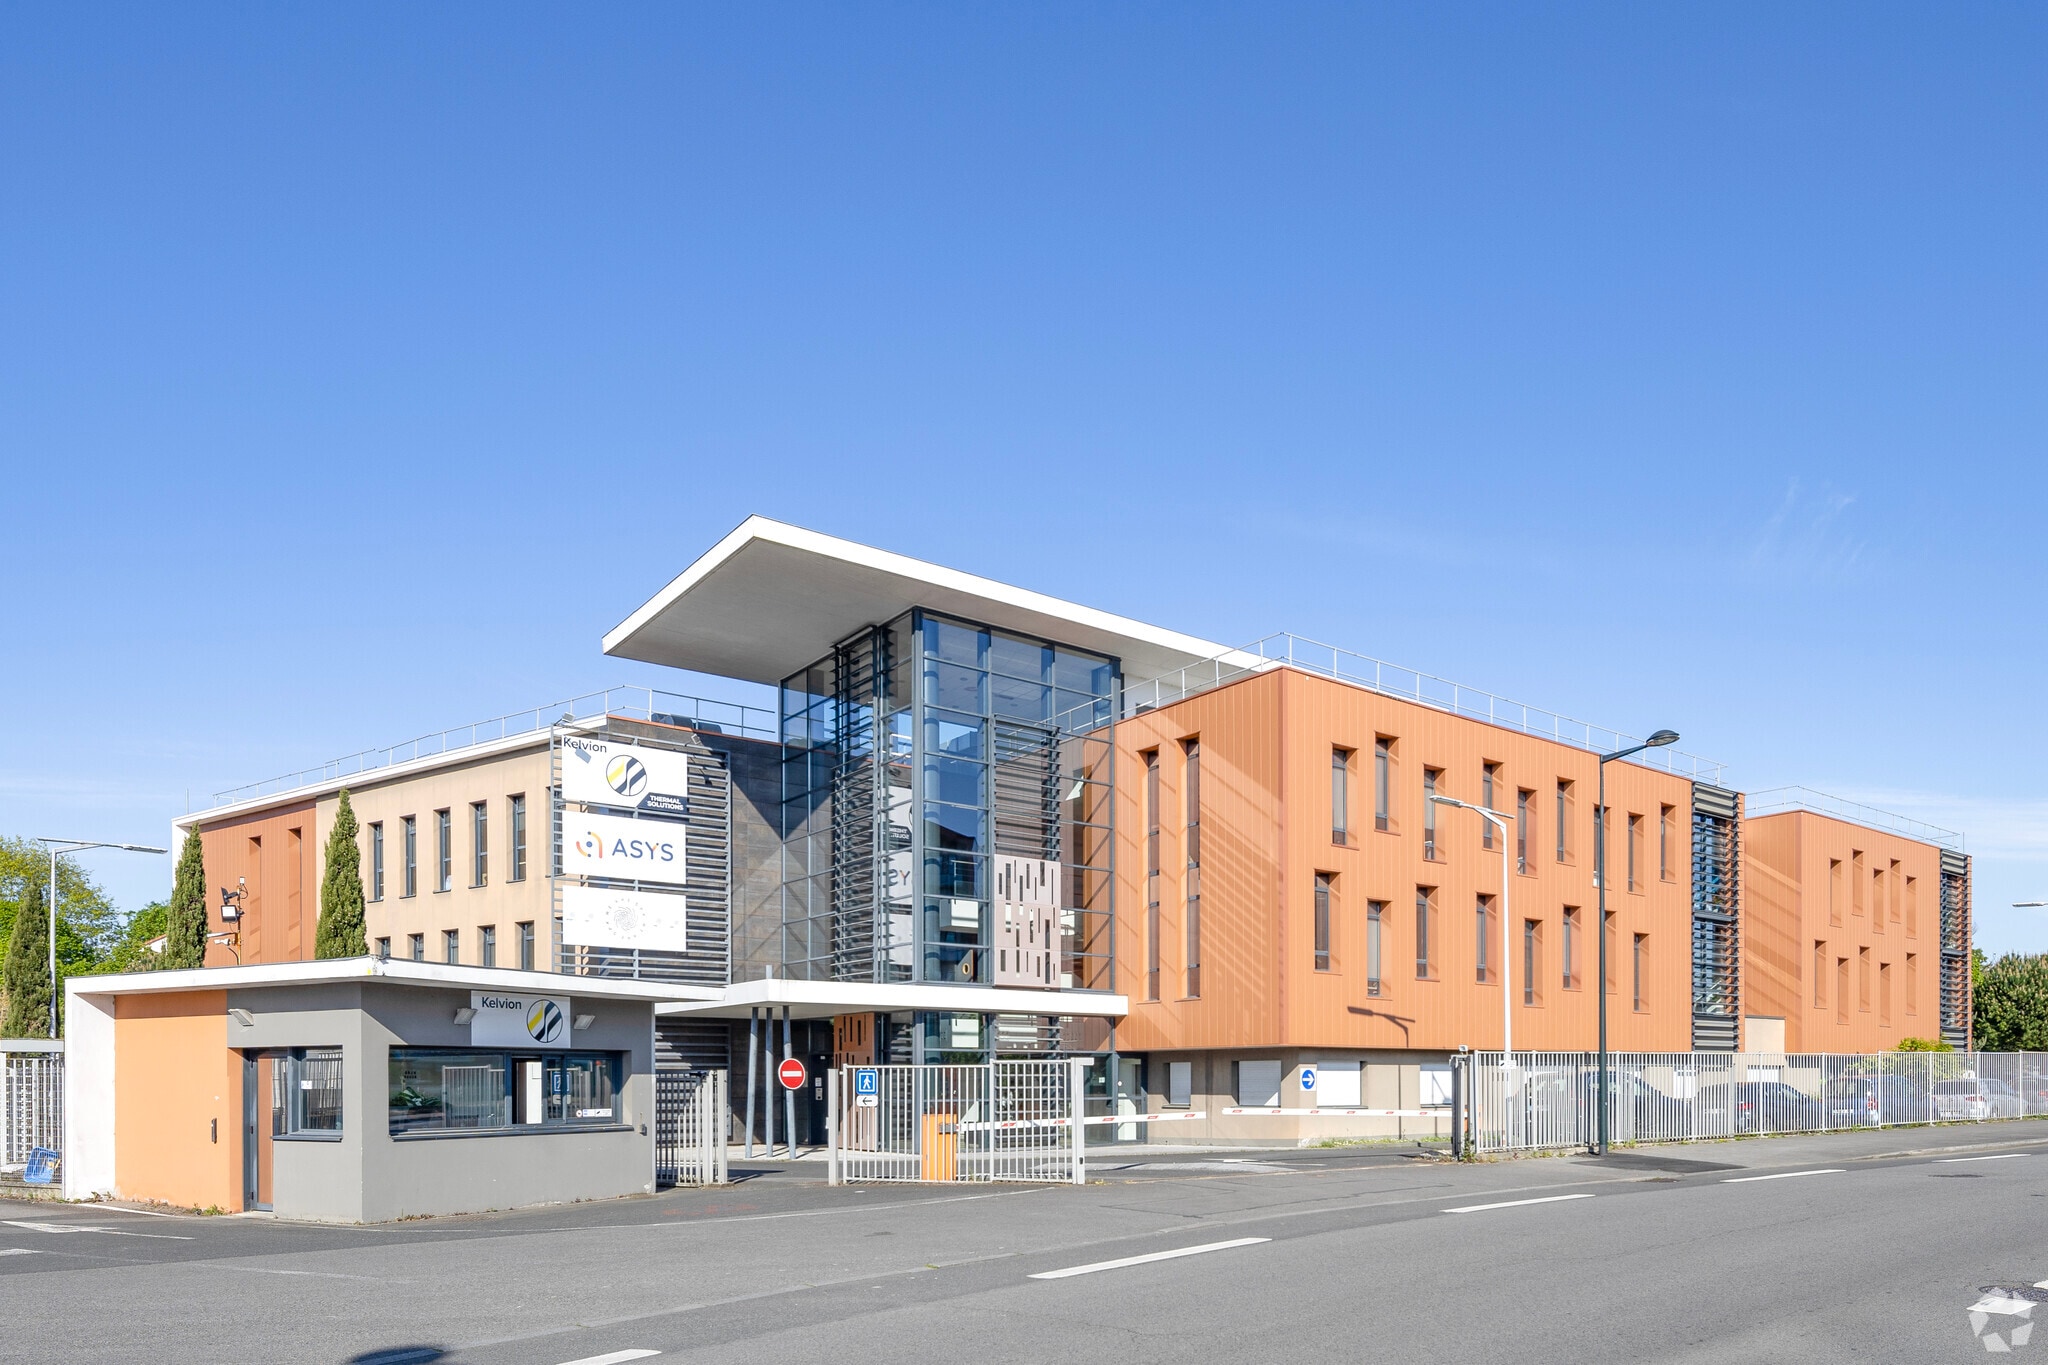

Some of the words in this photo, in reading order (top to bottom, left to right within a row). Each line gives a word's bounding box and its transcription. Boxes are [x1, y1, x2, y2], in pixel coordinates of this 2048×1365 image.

[564, 736, 607, 753] Kelvion
[647, 801, 684, 811] SOLUTIONS
[650, 795, 681, 804] THERMAL
[612, 838, 674, 861] ASYS
[481, 997, 522, 1010] Kelvion
